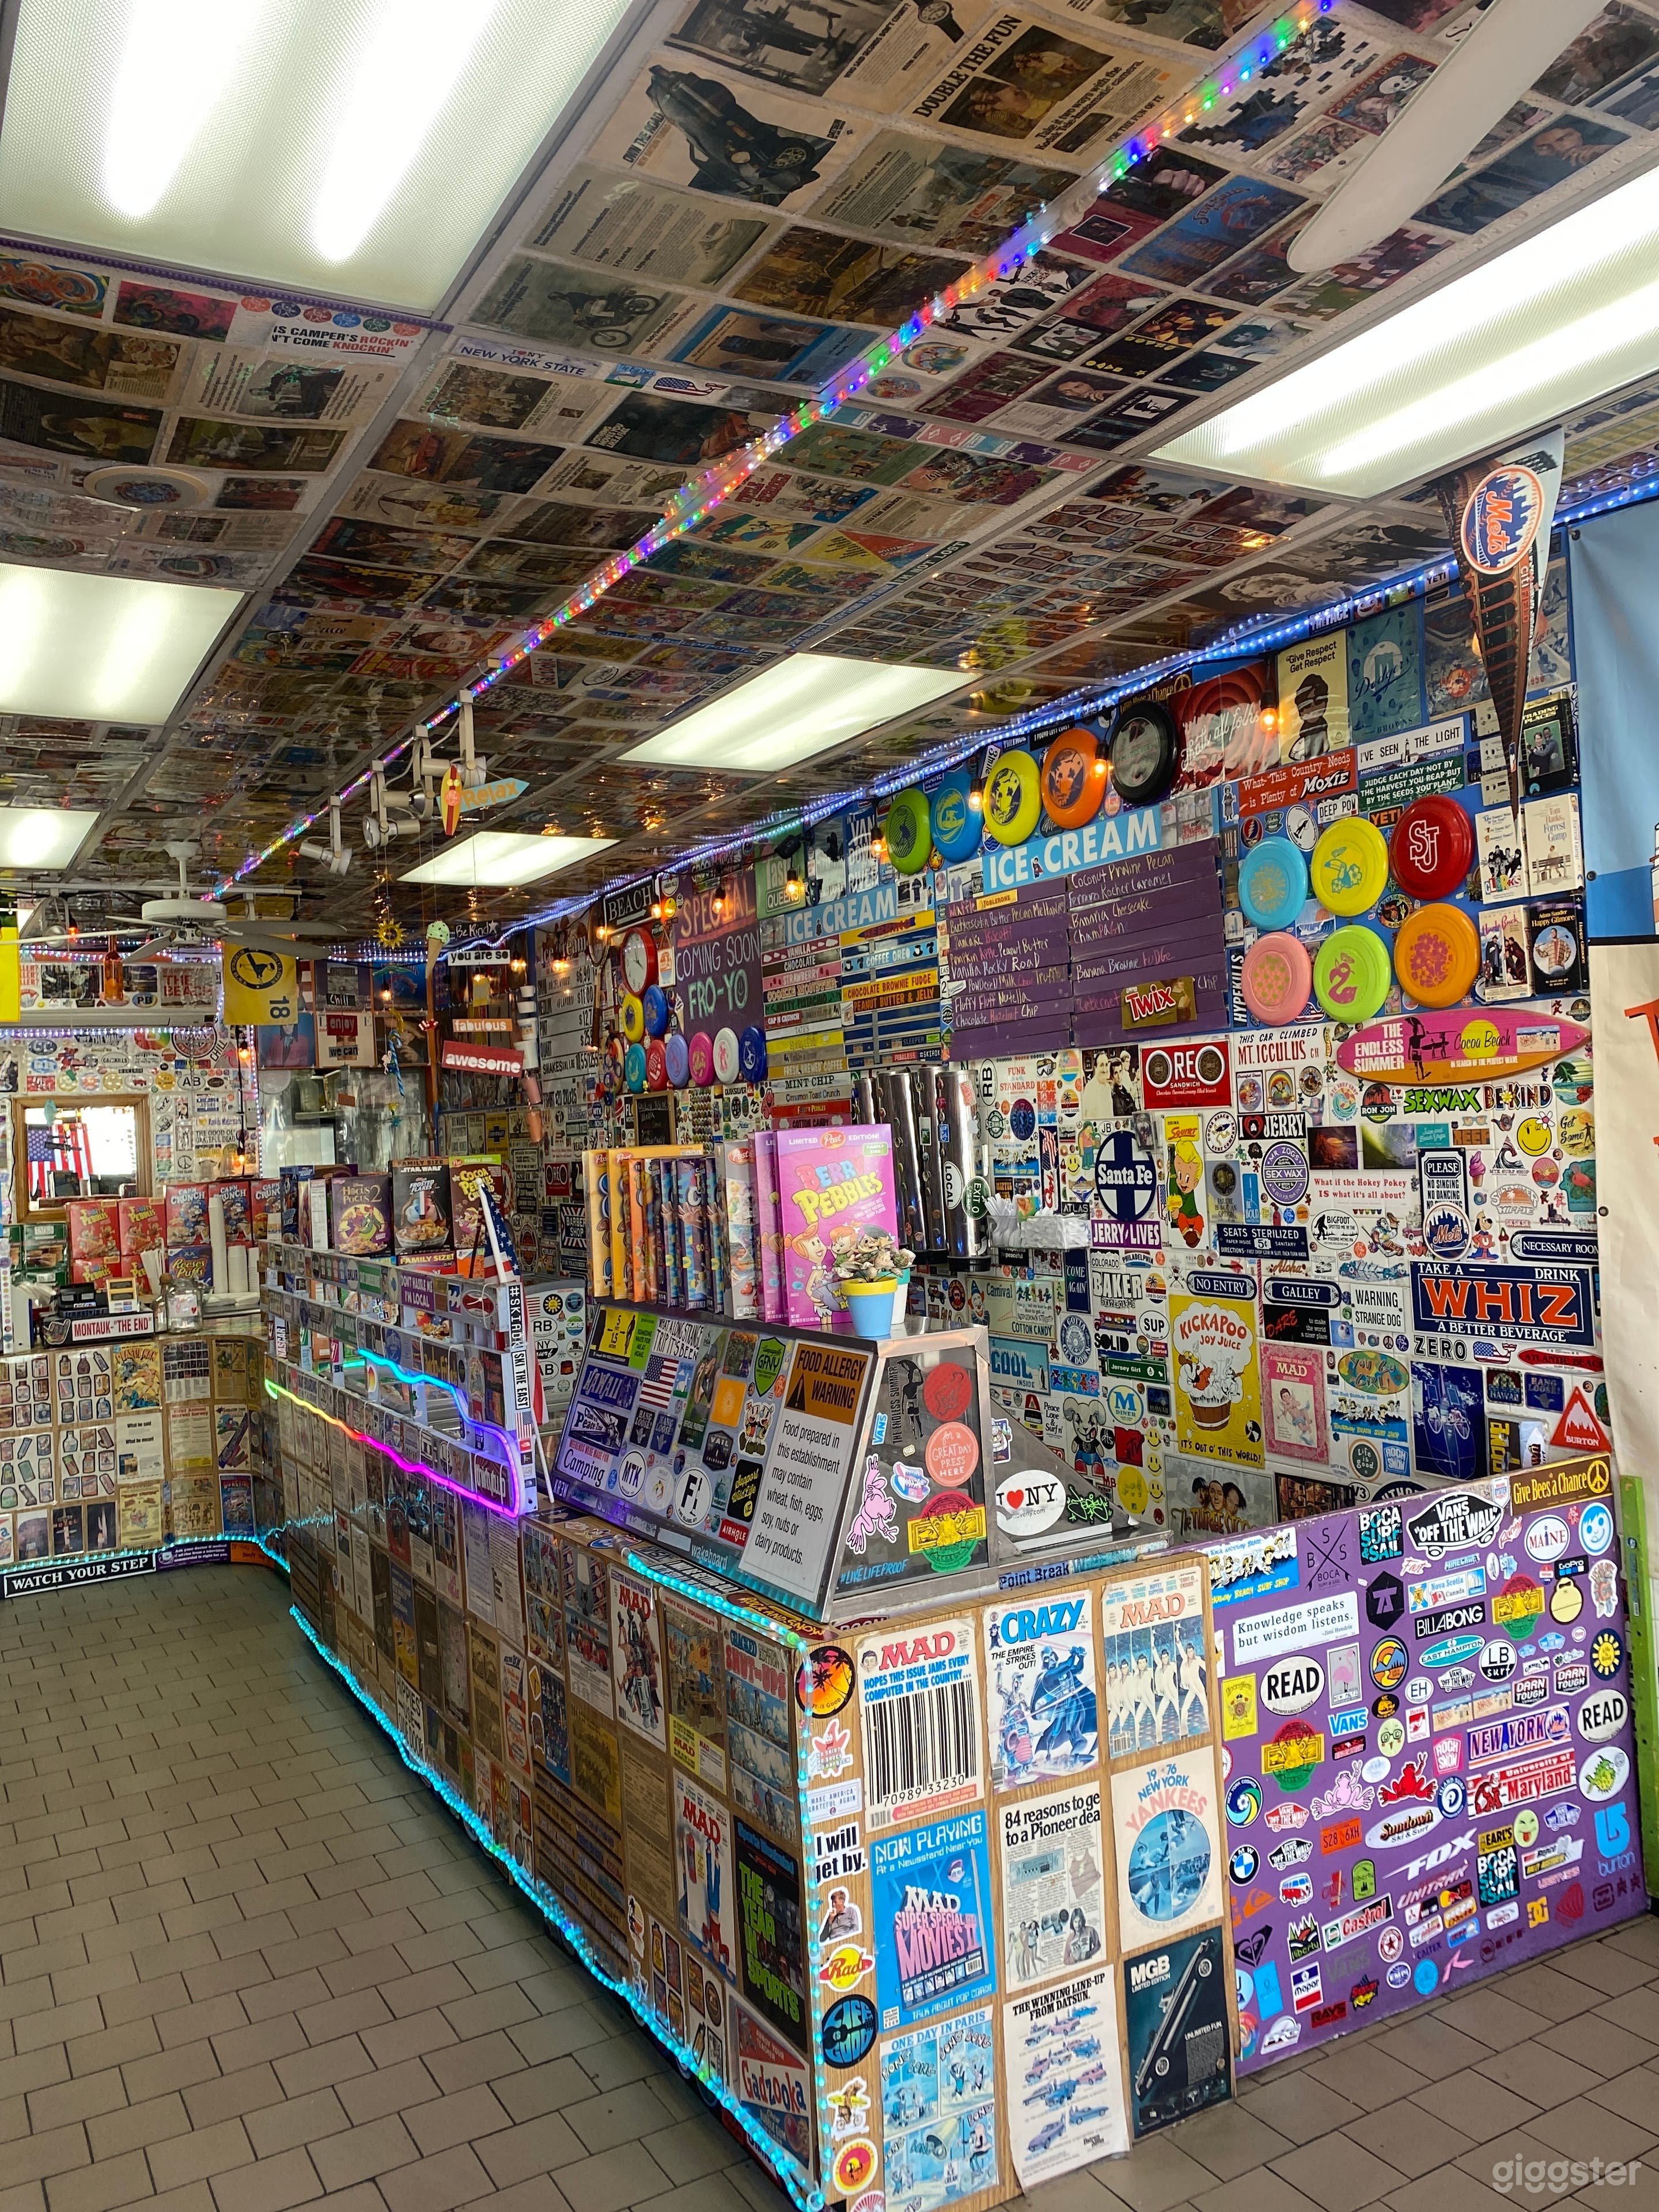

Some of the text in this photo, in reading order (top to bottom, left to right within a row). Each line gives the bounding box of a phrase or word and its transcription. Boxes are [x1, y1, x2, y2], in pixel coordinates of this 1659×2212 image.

[912, 14, 1022, 118] DOUBLE THE FUN
[290, 328, 414, 347] CAMPER'S ROCKIN'
[293, 338, 394, 354] COME KNOCKIN'
[461, 346, 586, 376] NEW YORK STATE
[1486, 491, 1513, 555] Mets
[1290, 651, 1335, 673] Get Respect
[1306, 641, 1336, 658] Respect
[1360, 727, 1460, 763] I'VE SEEN THE LIGHT
[1243, 753, 1350, 790] What This Country Needs
[1365, 777, 1387, 787] JUDGE
[1389, 771, 1408, 782] EACH
[1426, 763, 1441, 772] NOT
[1444, 760, 1453, 768] BY
[1376, 781, 1407, 793] HARVEST
[1408, 777, 1423, 785] YOU
[1426, 772, 1444, 782] REAP
[1448, 767, 1461, 777] BUT
[1249, 797, 1256, 807] is
[1260, 790, 1286, 805] Plenty
[1290, 785, 1297, 796] of
[1377, 793, 1390, 802] THE
[1393, 787, 1414, 798] SEEDS
[1416, 782, 1431, 793] YOU
[1434, 778, 1458, 789] PLANT.
[990, 809, 1158, 889] ICE CREAM
[607, 889, 653, 921] BEACH
[786, 888, 895, 942] ICE CREAM
[451, 953, 471, 963] you
[475, 952, 492, 960] are
[676, 932, 760, 981] COMING SOON
[783, 955, 816, 971] CHOCOLATE
[787, 945, 811, 956] VANILLA
[866, 952, 889, 967] COFFEE
[688, 971, 748, 1020] FRO-YO
[848, 974, 931, 998] CHOCOLATE BROWNIE FUDGE
[854, 987, 934, 1012] PEANUT BUTTER & JELLY
[955, 988, 1031, 1013] Fluffy Fluff Nutella
[454, 1020, 507, 1032] fabulous
[1240, 1028, 1317, 1044] THIS CAR CLIMBED
[1382, 1024, 1404, 1038] THE
[1453, 1028, 1511, 1050] Cocoa Beach
[1238, 1040, 1306, 1065] MT. ICCULUS
[1354, 1039, 1404, 1058] ENDLESS
[445, 1052, 521, 1074] awesome
[1354, 1055, 1405, 1073] SUMMER
[785, 1075, 835, 1089] MINT CHIP
[1361, 1104, 1396, 1114] RON JON
[1403, 1088, 1483, 1112] SEXWAX
[788, 1132, 879, 1145] LIMITED EDITION!
[1098, 1165, 1153, 1185] Santa Fe
[1358, 1179, 1380, 1187] Hokey
[1384, 1179, 1407, 1188] Pokey
[791, 1172, 884, 1224] PEBBLES
[1093, 1222, 1160, 1245] JERRY LIVES
[1523, 1241, 1572, 1253] NECESSARY
[1418, 1263, 1579, 1281] TAKE A DRINK
[1198, 1278, 1245, 1295] NO ENTRY
[1282, 1286, 1321, 1300] GALLEY
[1355, 1290, 1399, 1309] WARNING
[1422, 1278, 1577, 1327] WHIZ
[1179, 1313, 1248, 1340] KICKAPOO
[1355, 1312, 1402, 1327] STRANGE DOG
[798, 1347, 866, 1382] FOOD ALLERGY
[514, 1353, 528, 1406] SKI THE EAST
[811, 1380, 855, 1411] WARNING
[782, 1419, 840, 1449] Food prepared in
[778, 1442, 840, 1474] this establishment
[755, 1532, 802, 1565] dairy products.
[12, 1558, 149, 1589] WATCH YOUR STEP
[999, 1562, 1070, 1590] Point Break
[1001, 1600, 1086, 1645] CRAZY
[1237, 1600, 1346, 1634] Knowledge speaks
[1416, 1605, 1483, 1637] BILLABONG
[879, 1630, 955, 1671] MAD
[1267, 1667, 1320, 1700] READ
[1471, 1715, 1546, 1755] NEW YORK
[1507, 1767, 1571, 1801] Maryland
[1125, 1792, 1207, 1832] YANKEES
[1342, 1901, 1388, 1938] Castrol
[1130, 1955, 1170, 1984] MGB
[891, 2010, 986, 2051] ONE DAY IN PARIS
[741, 2058, 805, 2111] Gadzooka
